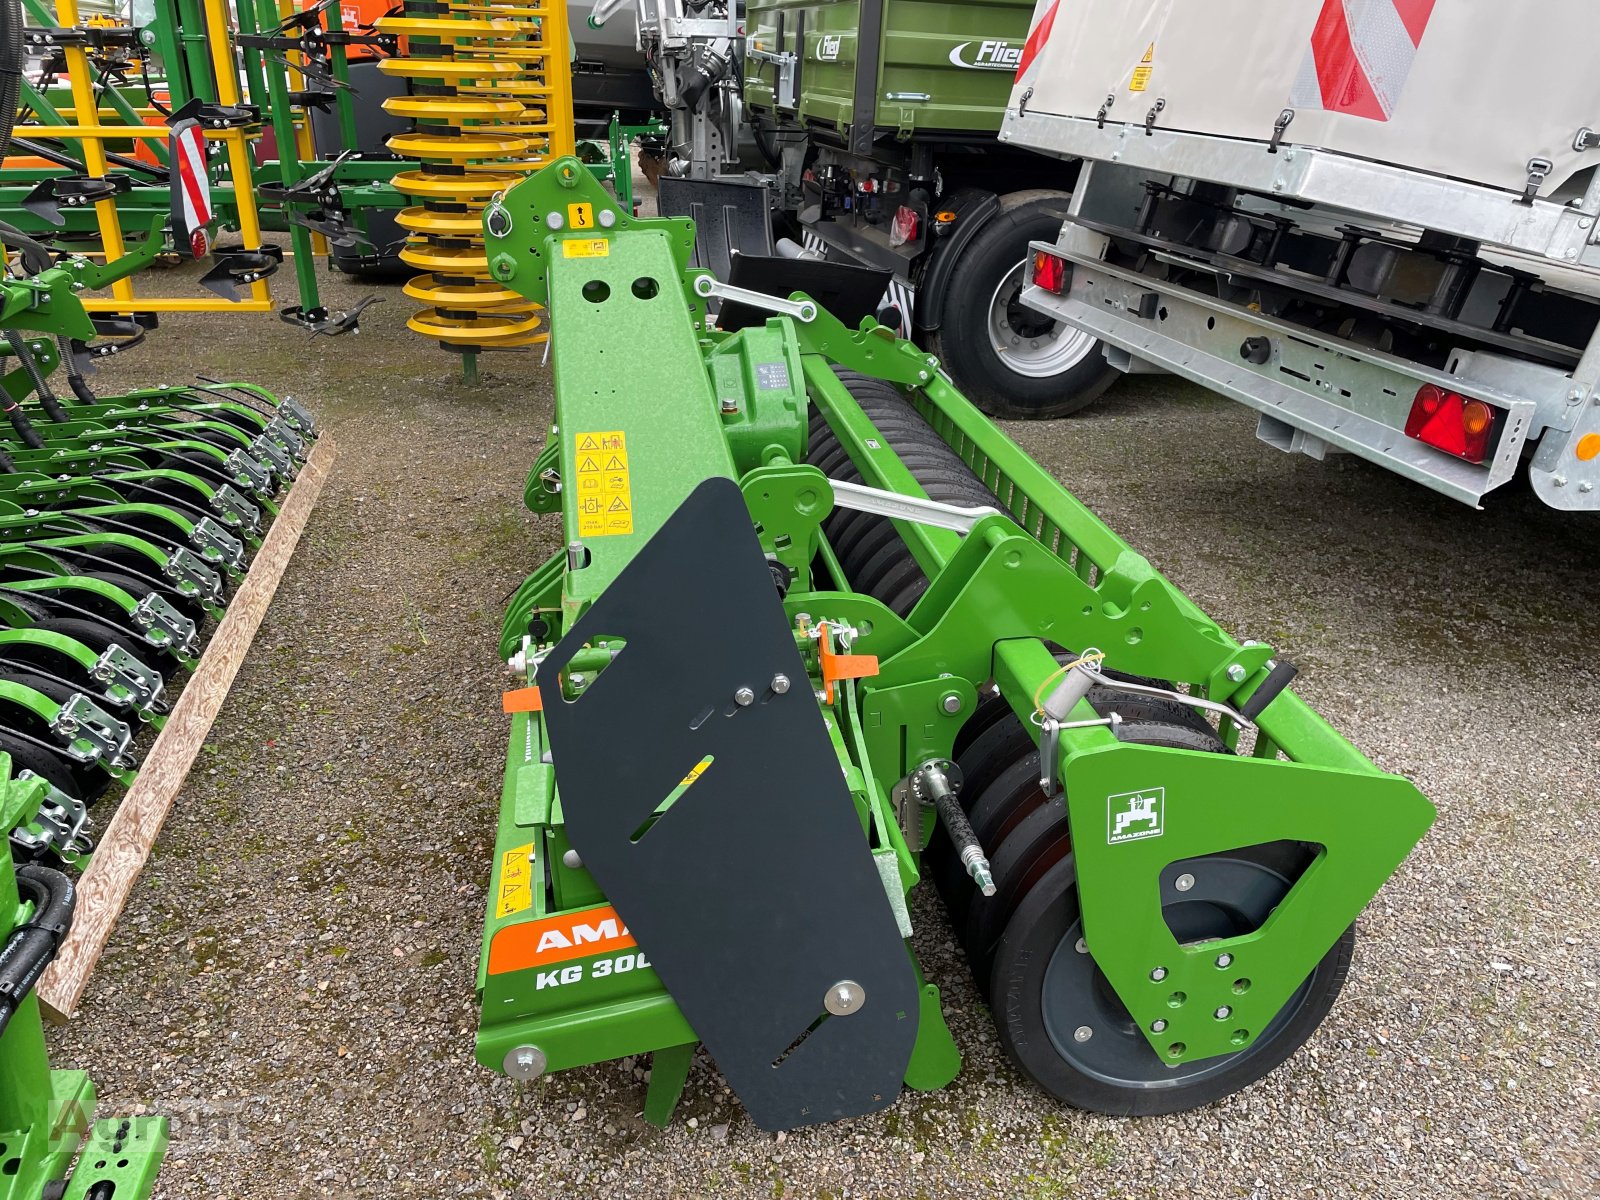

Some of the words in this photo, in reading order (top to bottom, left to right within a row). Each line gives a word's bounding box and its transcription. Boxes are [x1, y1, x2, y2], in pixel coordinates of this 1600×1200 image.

[1110, 829, 1160, 841] AMAZONE
[536, 918, 630, 953] AM
[536, 965, 583, 990] KG
